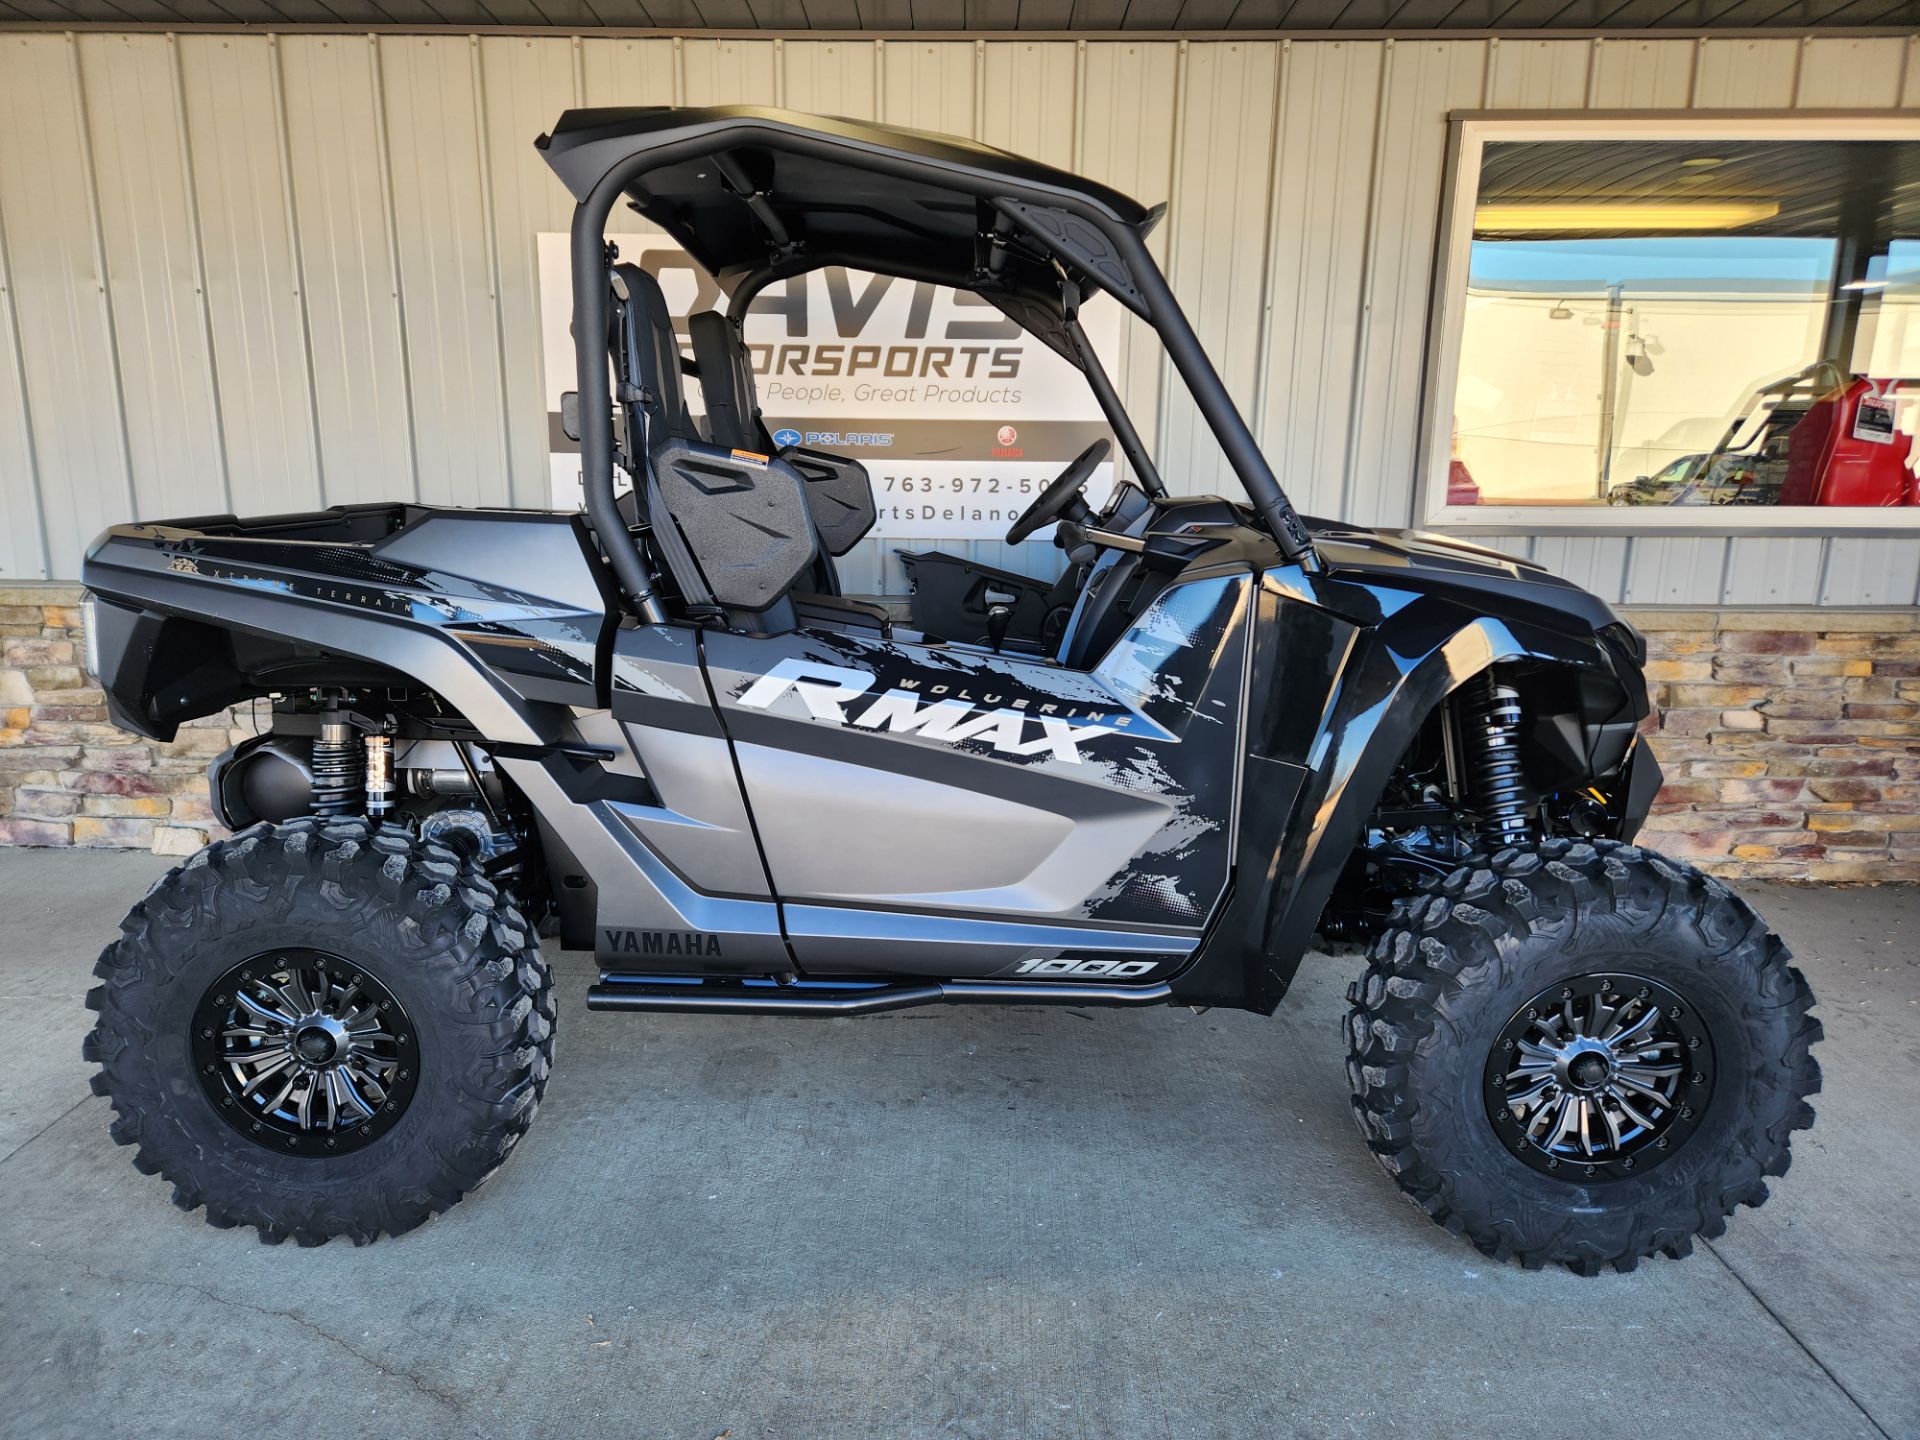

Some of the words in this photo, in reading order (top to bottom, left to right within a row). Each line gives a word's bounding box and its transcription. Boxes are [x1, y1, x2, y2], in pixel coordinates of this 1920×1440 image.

[742, 344, 1023, 379] ORSPORTS
[766, 382, 845, 402] People,
[854, 383, 917, 402] Great
[923, 384, 1022, 404] Products
[805, 432, 894, 446] POLARIS
[991, 447, 1024, 457] YAMAHA
[316, 586, 412, 612] TERRAIN
[736, 657, 1120, 765] RMAX
[604, 929, 722, 957] YAMAHA
[1014, 958, 1160, 977] 1000
